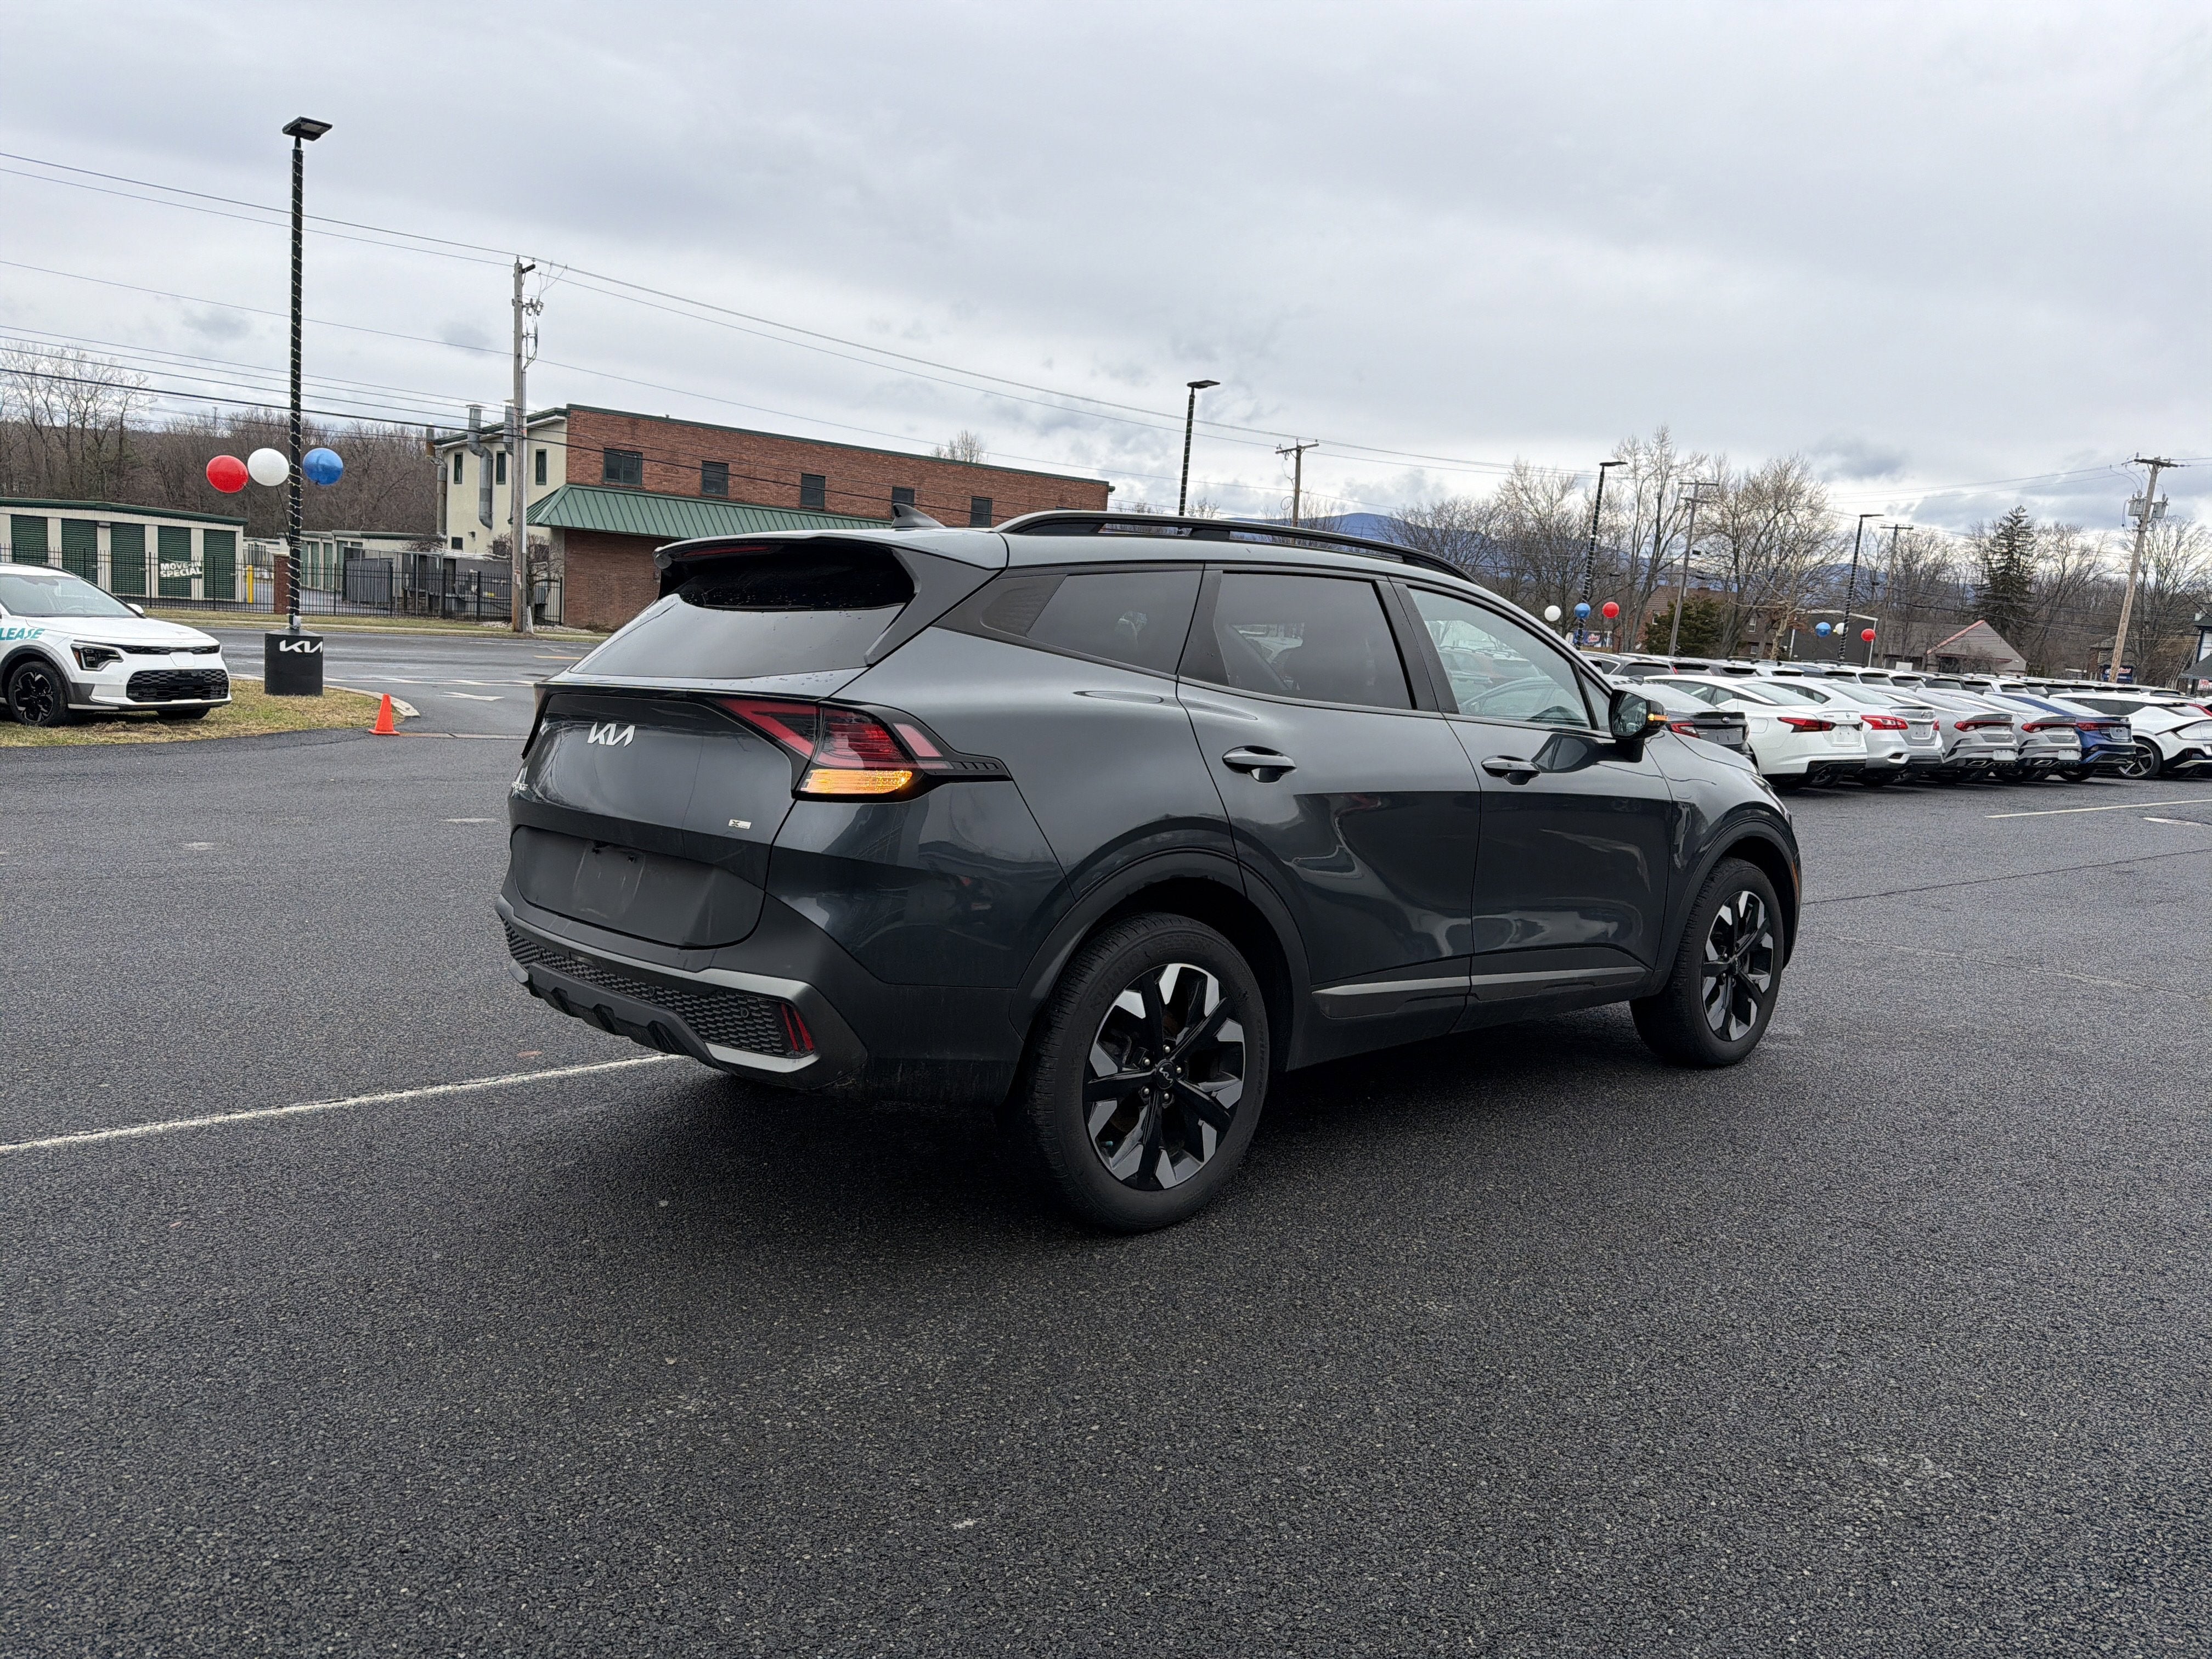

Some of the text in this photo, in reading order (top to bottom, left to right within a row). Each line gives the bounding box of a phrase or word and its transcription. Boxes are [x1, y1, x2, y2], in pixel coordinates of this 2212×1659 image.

[160, 561, 201, 571] MOVE-IN
[160, 567, 202, 577] SPECIAL
[0, 628, 44, 640] LEASE
[279, 640, 323, 653] KIA
[587, 721, 635, 747] KIA
